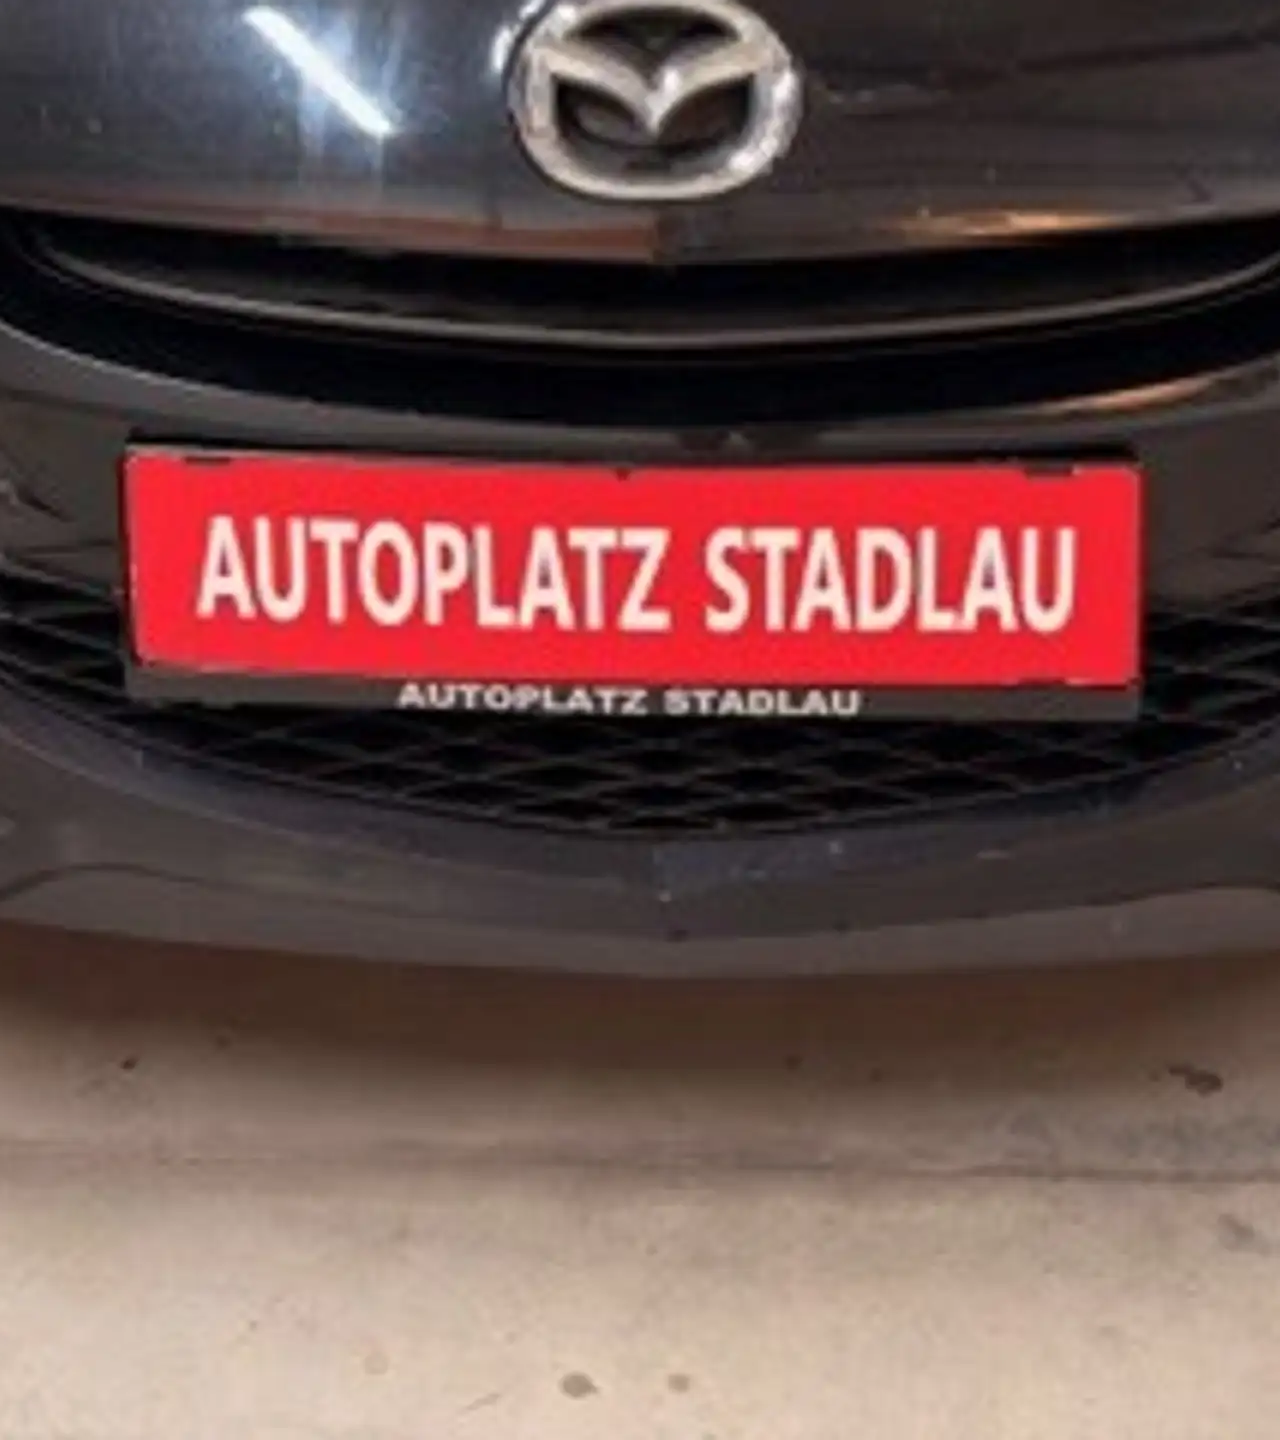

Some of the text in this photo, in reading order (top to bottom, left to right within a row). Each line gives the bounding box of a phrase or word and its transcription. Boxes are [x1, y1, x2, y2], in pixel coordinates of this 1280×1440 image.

[195, 515, 1075, 633] AUTOPLATZ STADLAU
[397, 682, 861, 716] AUTOPLATZ STADLAU
